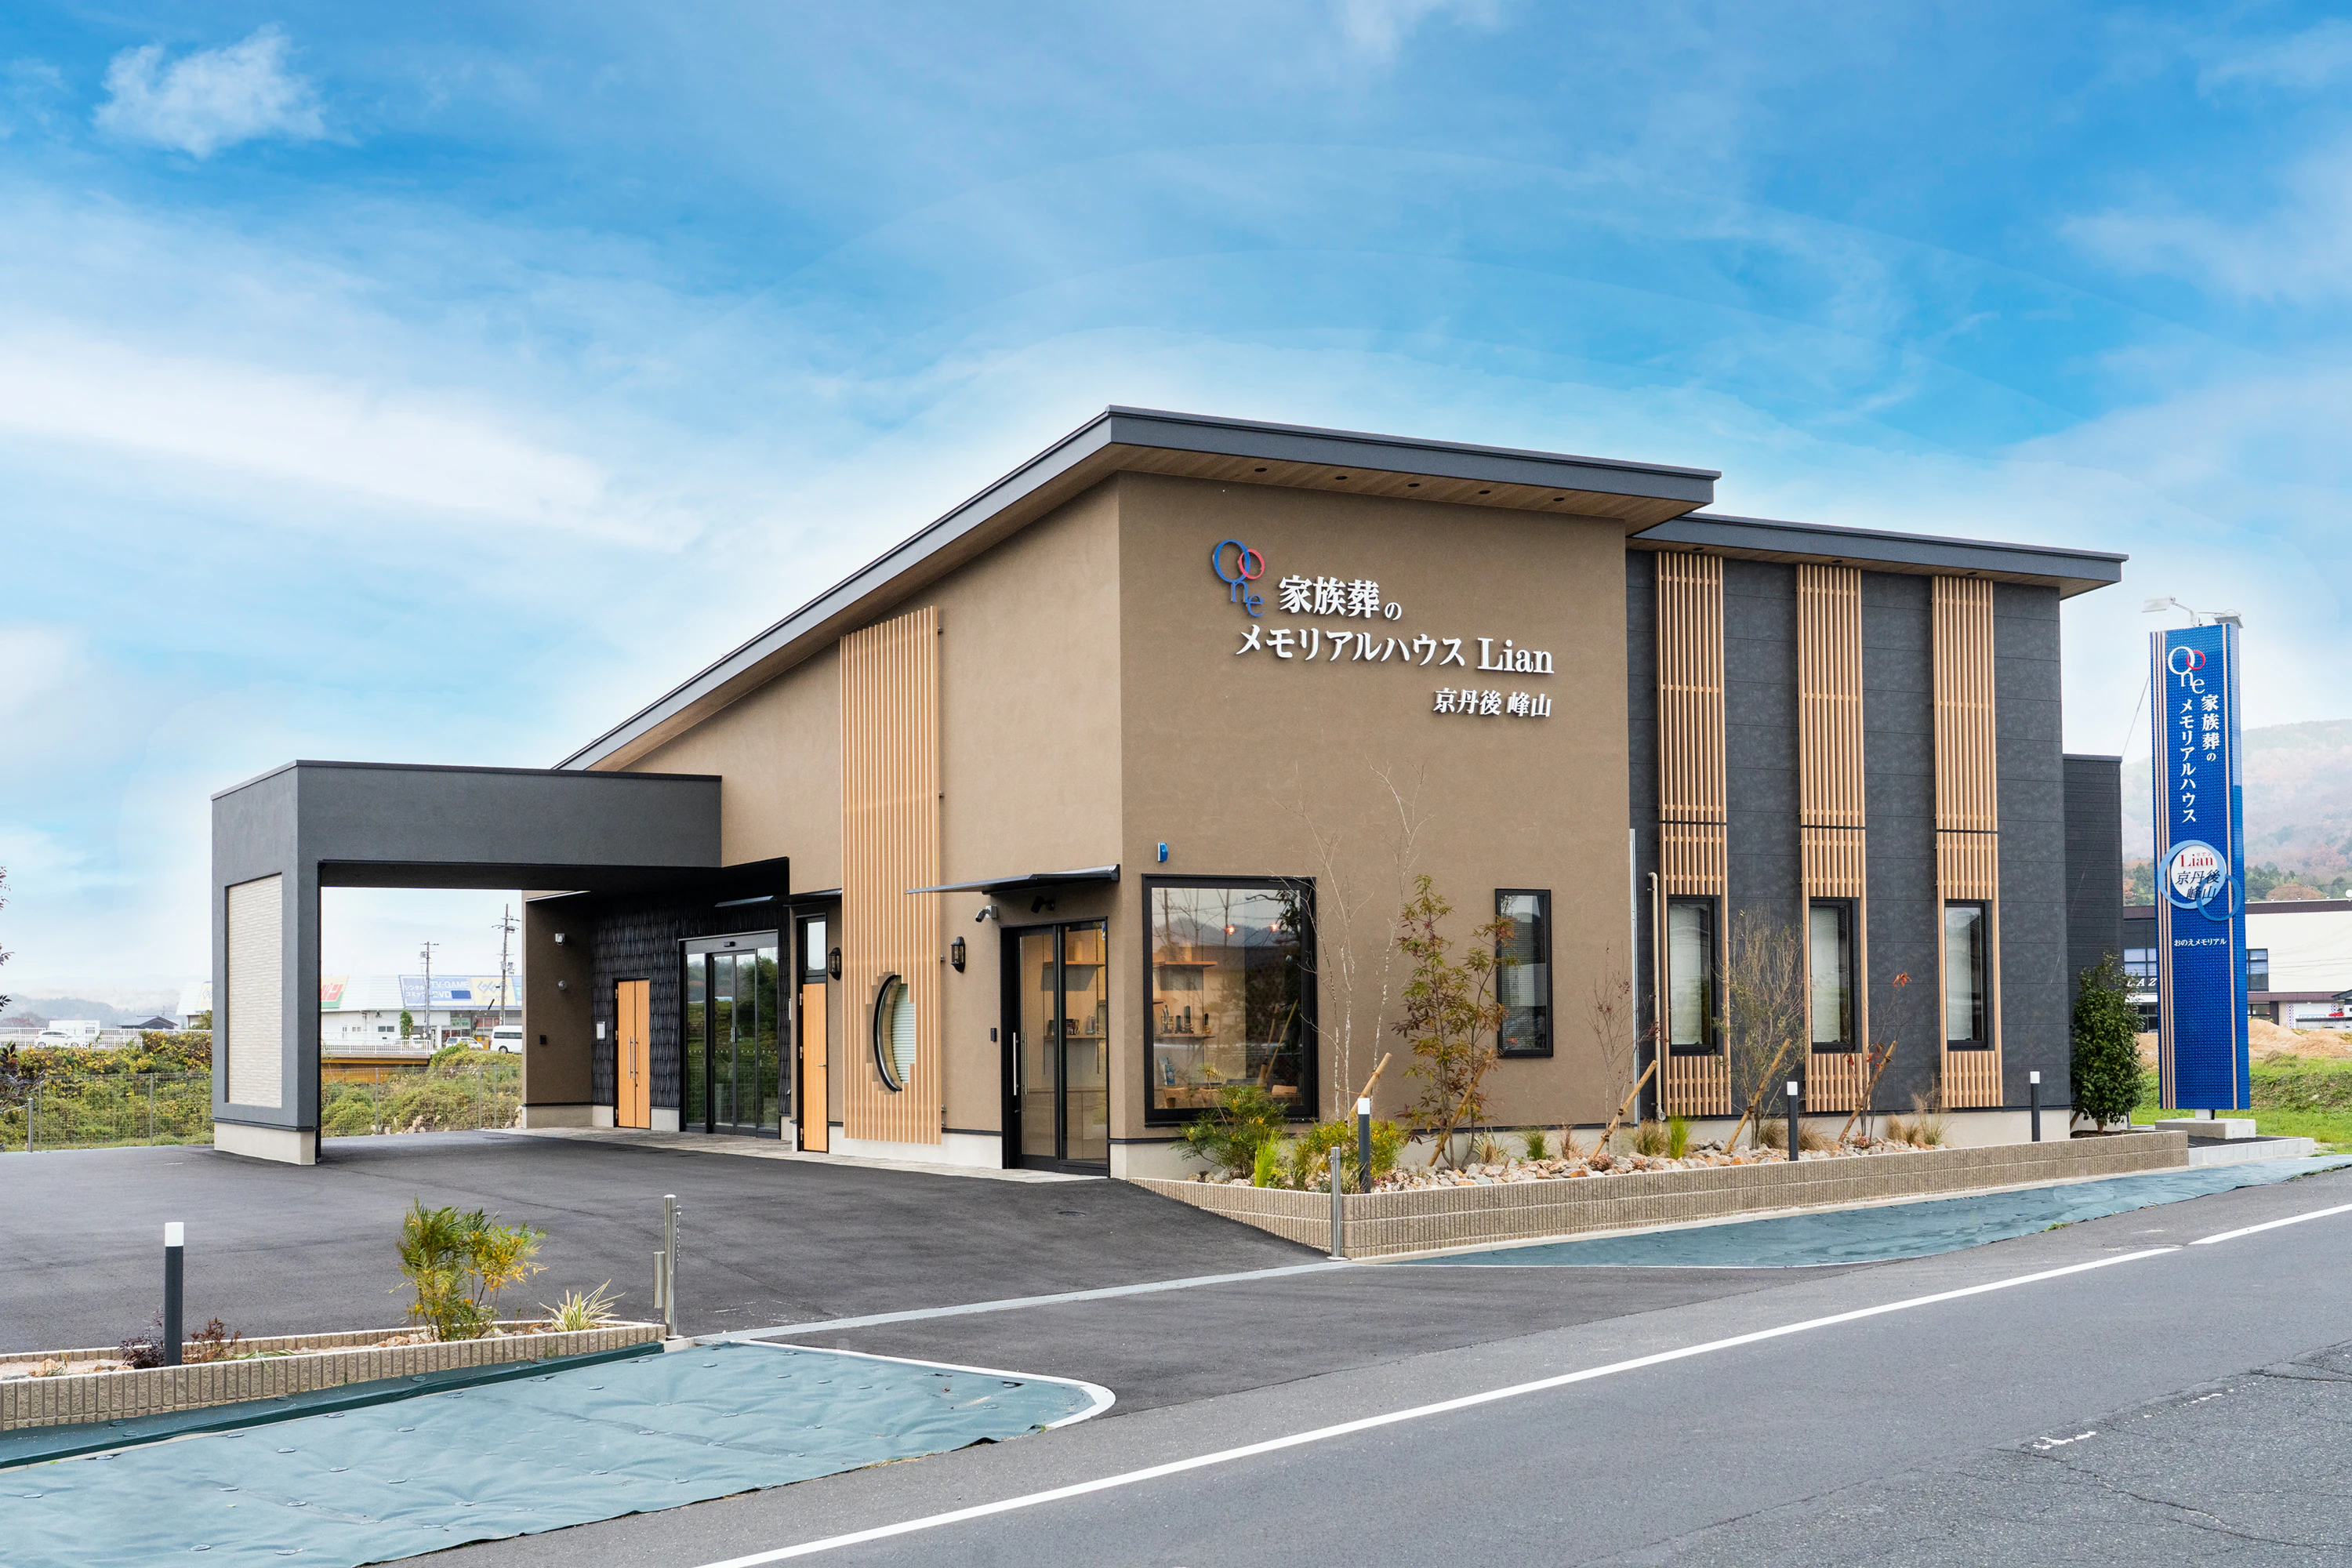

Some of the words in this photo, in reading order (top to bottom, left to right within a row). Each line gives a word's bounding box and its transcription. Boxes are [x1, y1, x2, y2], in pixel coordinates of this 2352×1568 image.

[1279, 575, 1403, 621] 家族葬の
[1236, 624, 1466, 667] メモリアルハウス
[1477, 637, 1555, 674] Lian
[1433, 688, 1501, 716] 京丹後
[1506, 691, 1552, 717] 峰山
[2201, 694, 2220, 762] 家族葬の
[2180, 699, 2196, 823] メモリアルハウス
[2180, 854, 2213, 867] Lian
[2175, 869, 2220, 885] 京丹後
[2187, 886, 2217, 900] 峰山
[2174, 938, 2227, 946] おのえメモリアル
